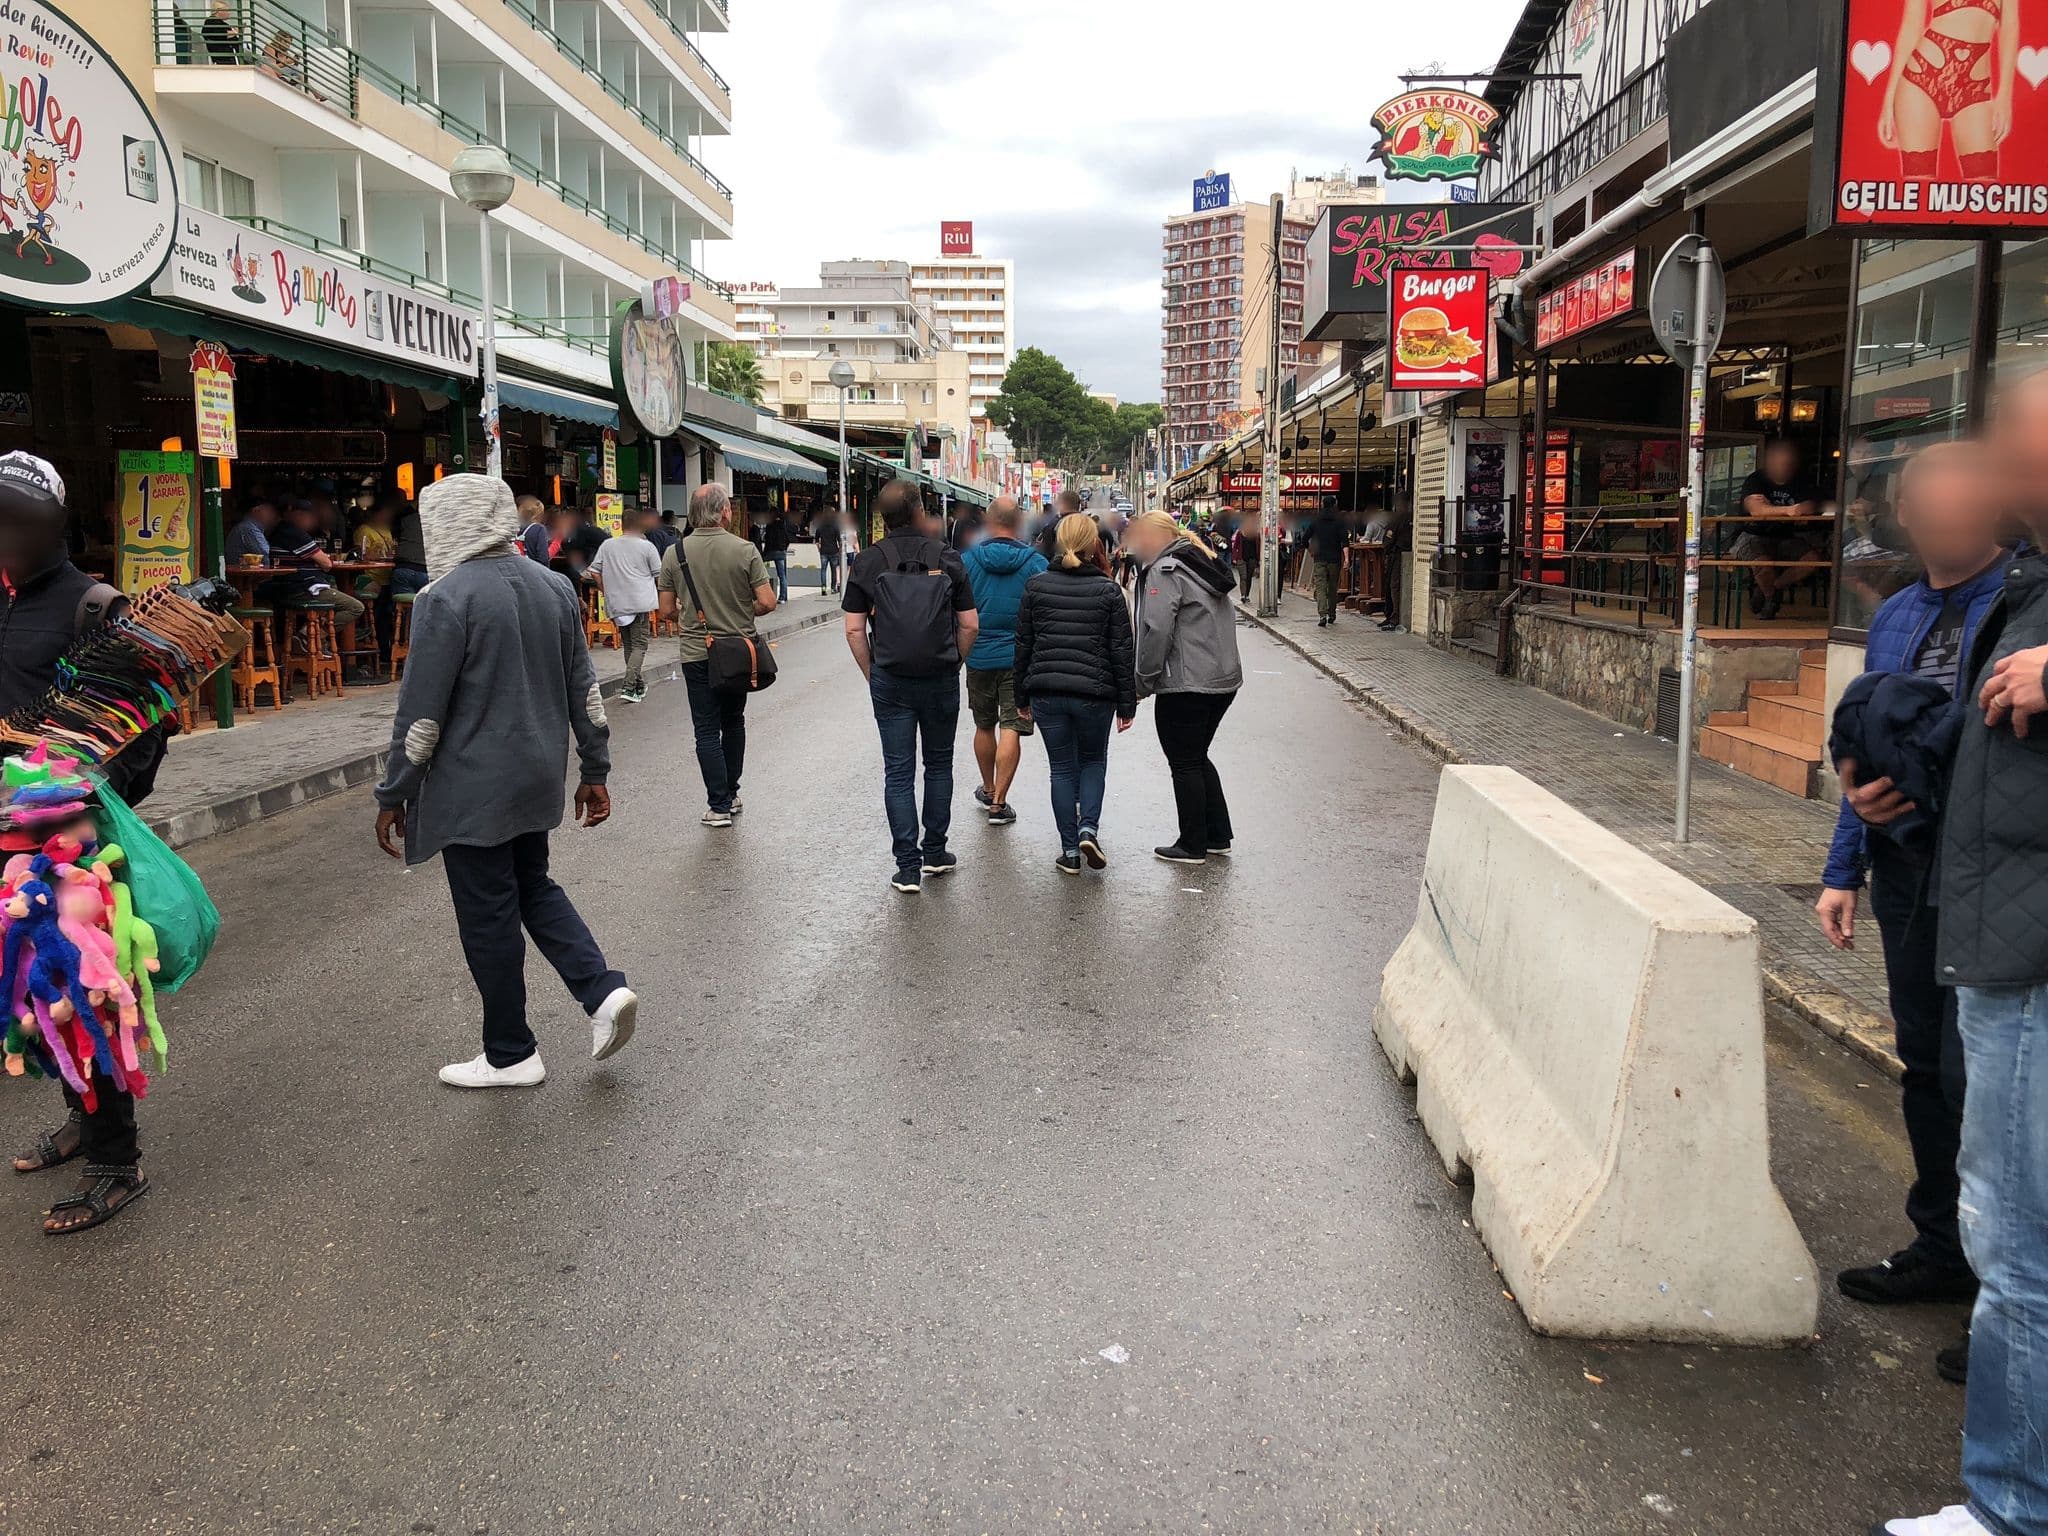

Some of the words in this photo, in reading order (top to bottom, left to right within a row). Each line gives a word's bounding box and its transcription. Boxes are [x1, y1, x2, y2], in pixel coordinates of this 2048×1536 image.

[8, 34, 54, 68] Revier
[30, 15, 94, 69] hier!!!!!
[1382, 94, 1490, 123] BIERKÖNIG
[131, 167, 154, 183] VELTINS
[1195, 183, 1226, 198] PABISA
[1841, 181, 1919, 211] GEILE
[1201, 196, 1220, 209] BALI
[187, 217, 201, 237] La
[1331, 208, 1450, 255] SALSA
[944, 233, 969, 245] RIU
[98, 271, 111, 284] La
[112, 249, 145, 279] cerveza
[142, 222, 165, 254] fresca
[173, 241, 217, 268] cerveza
[180, 266, 215, 292] fresca
[1352, 247, 1455, 288] ROSA
[751, 281, 777, 292] Park
[1403, 274, 1476, 302] Burger
[271, 249, 357, 329] Bamboleo
[388, 293, 473, 365] VELTINS
[208, 351, 216, 371] 1
[155, 474, 180, 485] VODKA
[1296, 475, 1333, 487] KÖNIG
[152, 486, 186, 499] CARAMEL
[143, 565, 182, 578] PICCOLO
